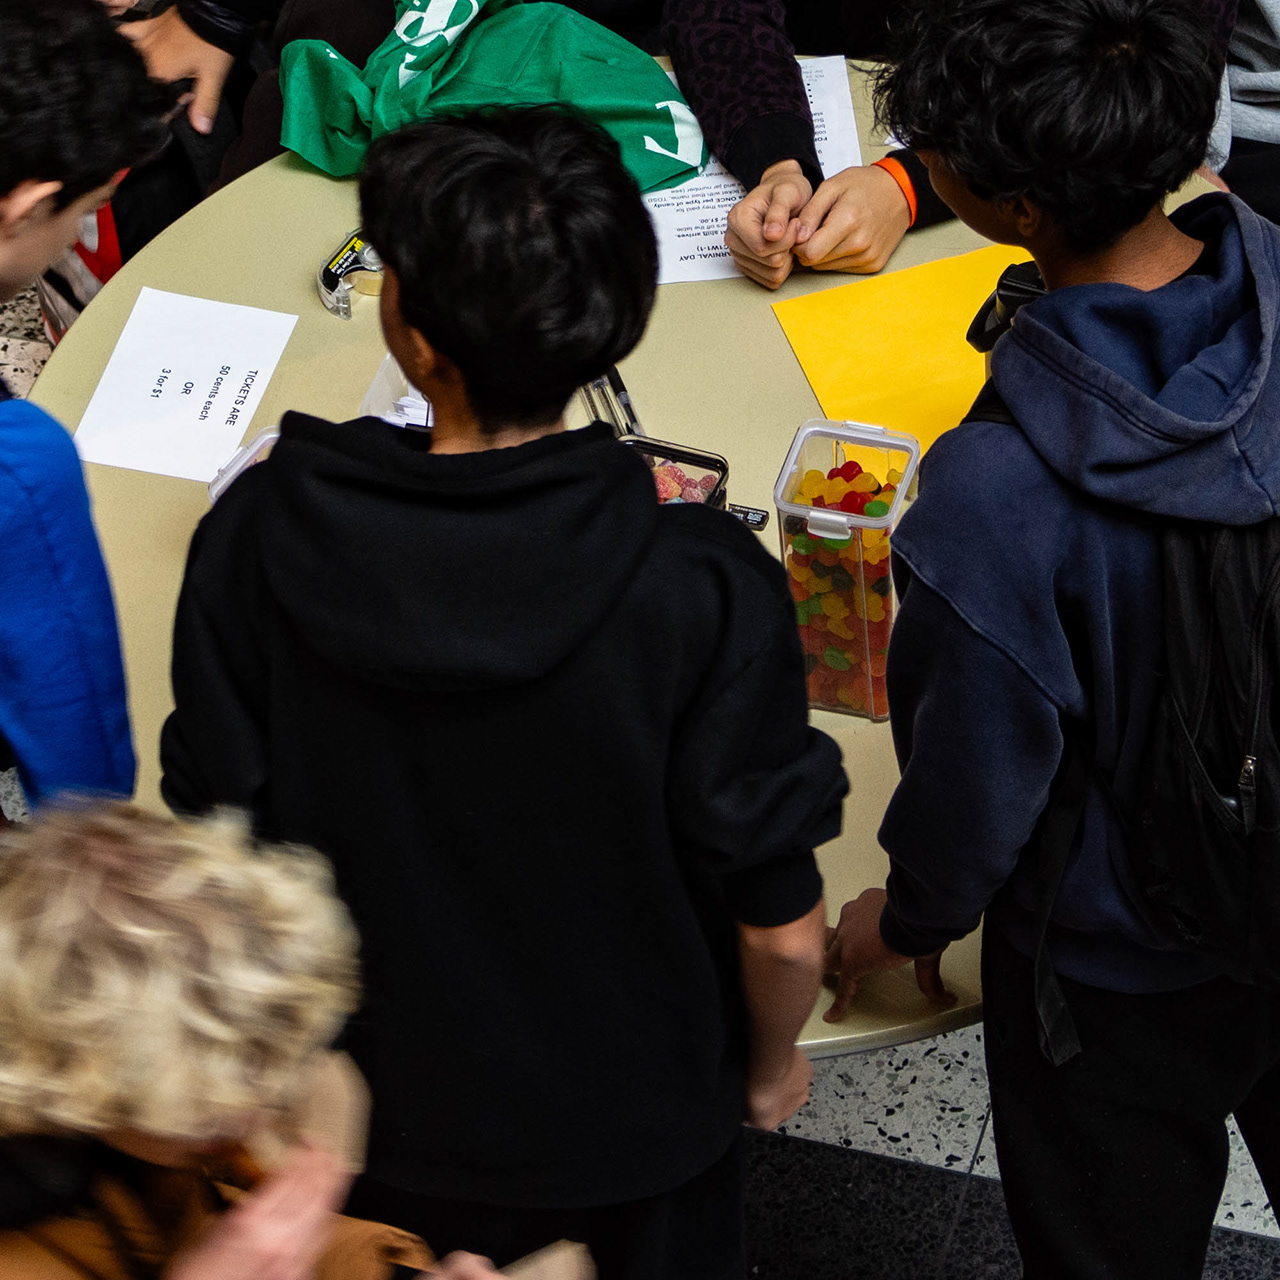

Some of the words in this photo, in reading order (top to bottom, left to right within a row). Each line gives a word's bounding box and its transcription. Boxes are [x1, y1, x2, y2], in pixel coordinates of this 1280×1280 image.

[679, 254, 696, 262] DAY
[696, 251, 732, 259] ARNIVAL
[219, 365, 231, 376] 50
[155, 375, 169, 387] for
[208, 376, 224, 399] cents
[234, 369, 259, 406] TICKETS
[150, 388, 163, 399] $1
[180, 381, 194, 395] OR
[198, 400, 213, 421] each
[225, 406, 241, 426] ARE
